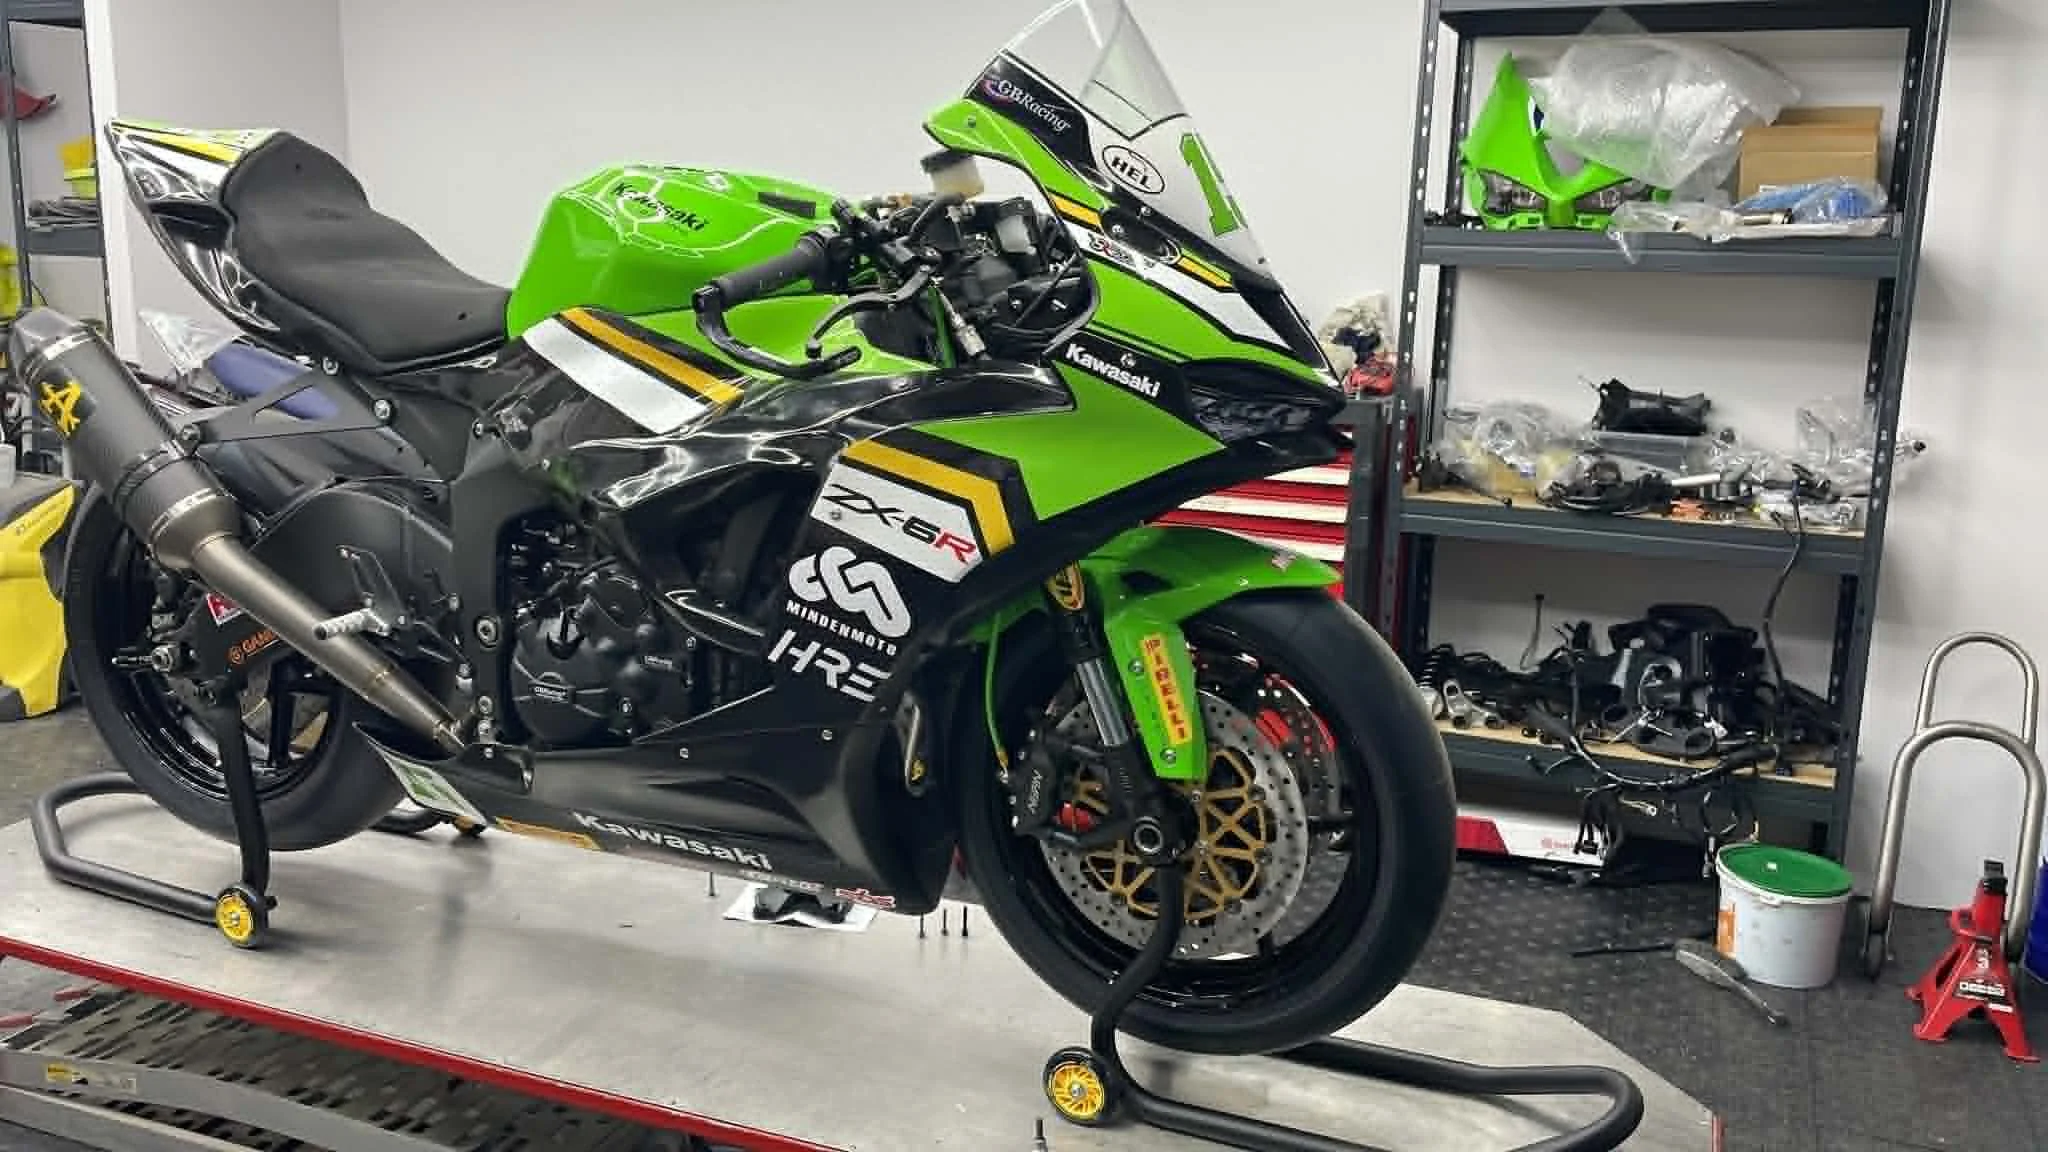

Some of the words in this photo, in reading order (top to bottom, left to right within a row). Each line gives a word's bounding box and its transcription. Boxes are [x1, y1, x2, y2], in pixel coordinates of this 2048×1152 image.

[998, 80, 1071, 132] GBRacing
[1111, 157, 1151, 190] HEL
[613, 183, 706, 231] Kawasaki
[1066, 344, 1160, 398] Kawasaki
[822, 484, 976, 565] ZX-6R
[786, 600, 897, 656] MINDENMOTO
[768, 629, 892, 702] HRE
[1144, 637, 1186, 740] PIRELLI
[572, 810, 773, 872] Kawasaki
